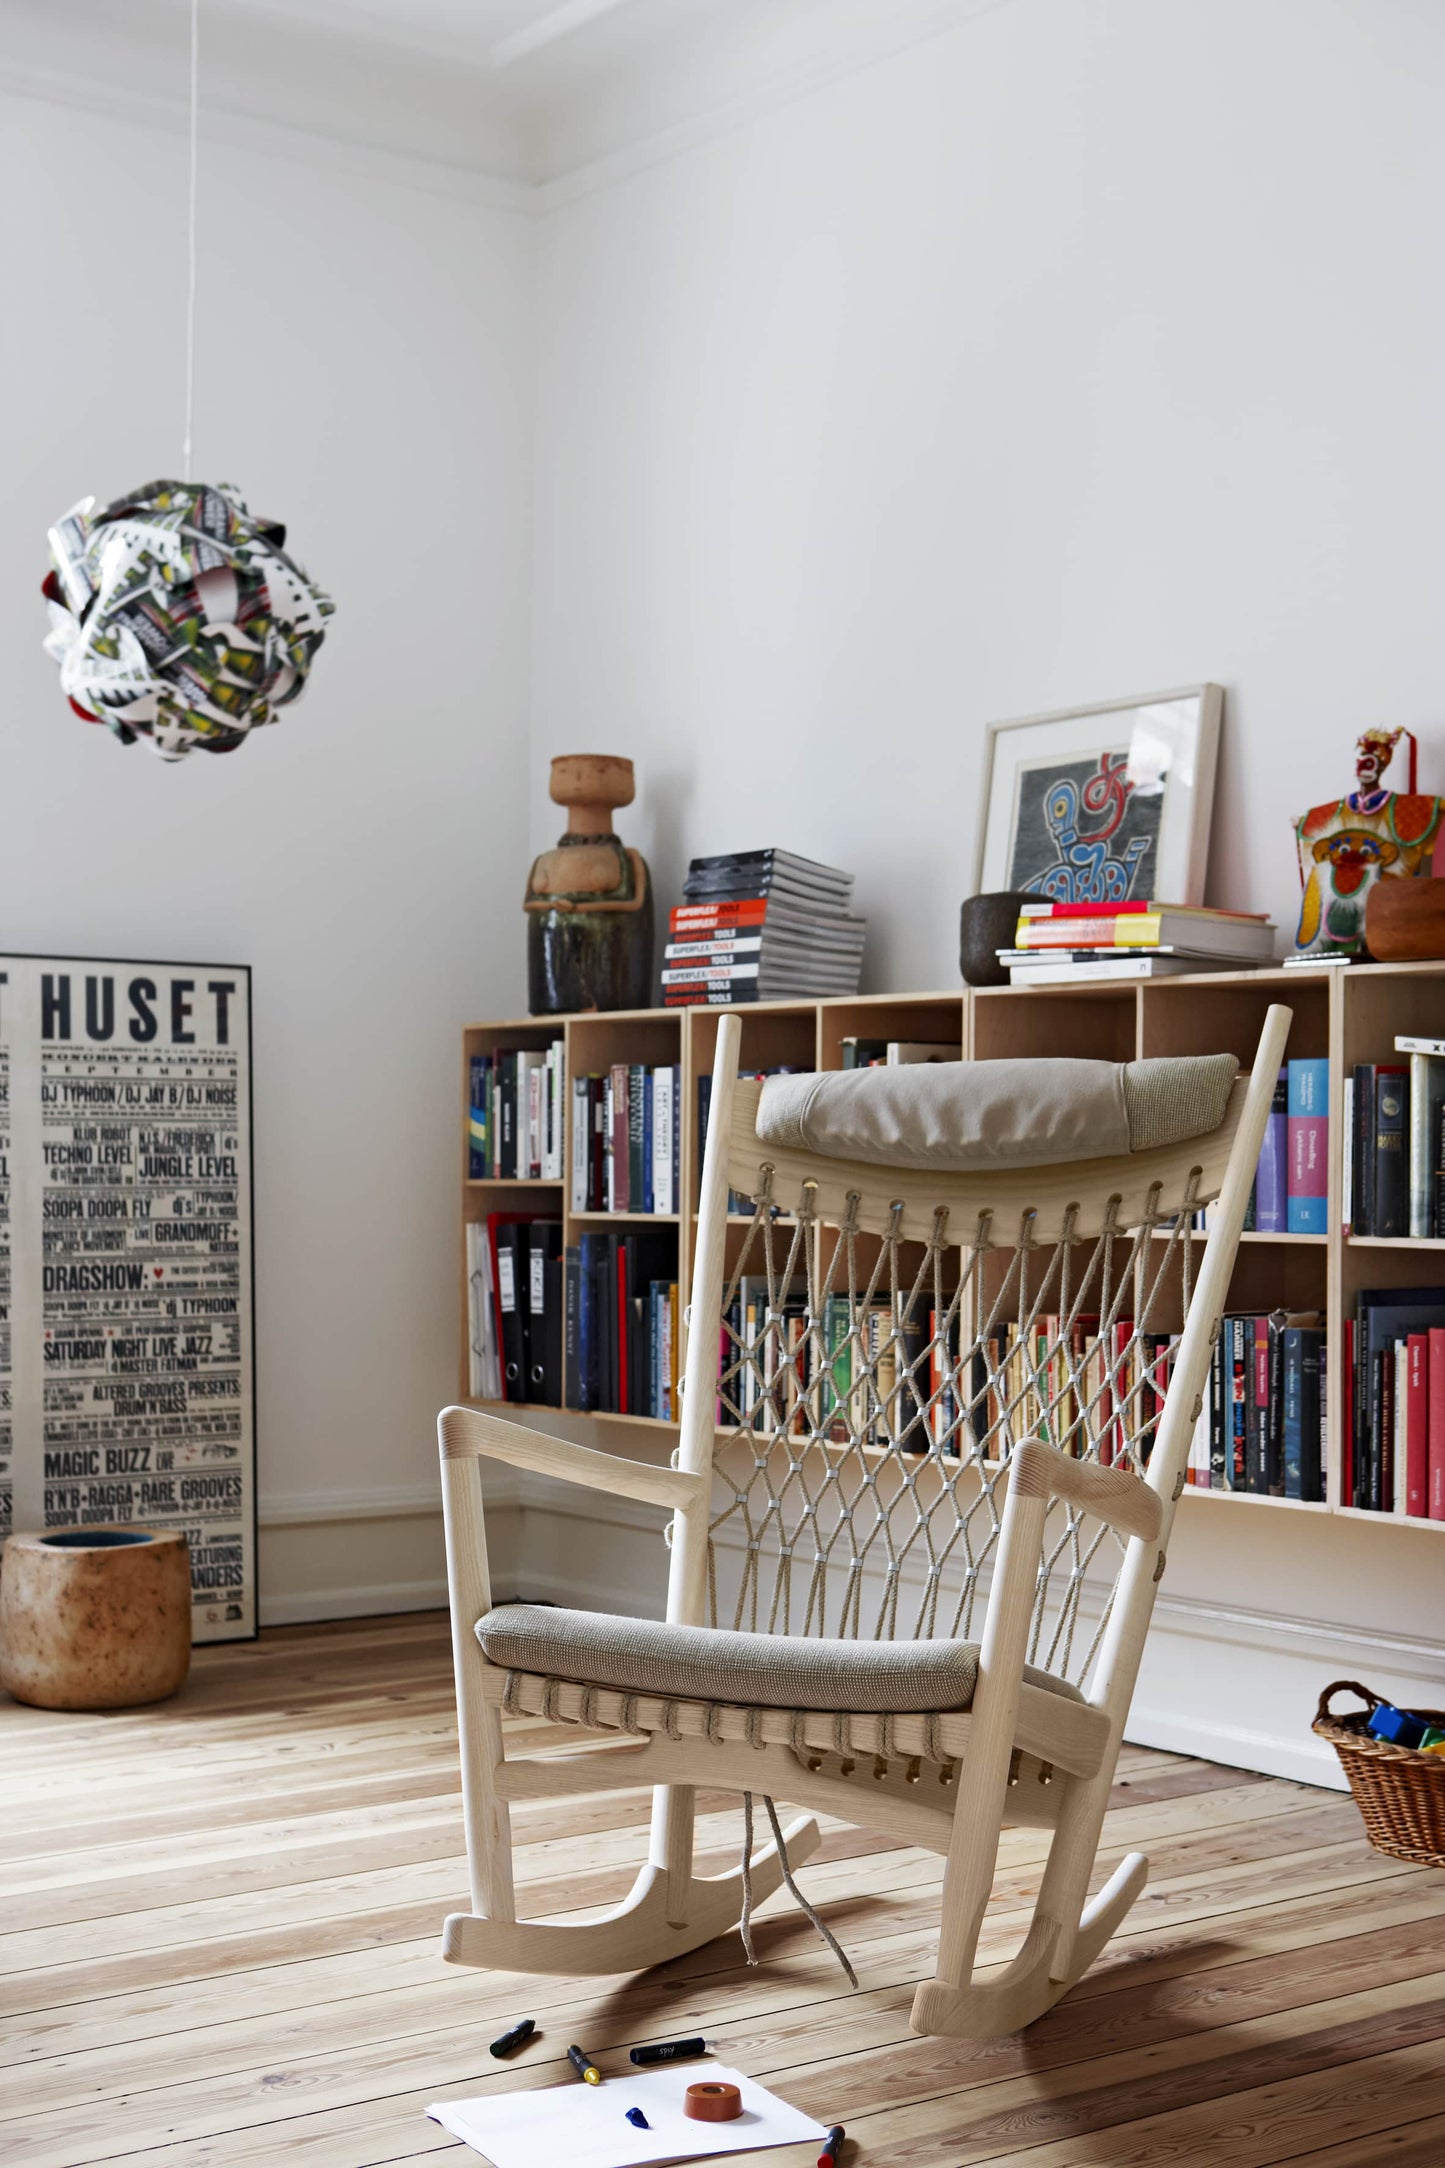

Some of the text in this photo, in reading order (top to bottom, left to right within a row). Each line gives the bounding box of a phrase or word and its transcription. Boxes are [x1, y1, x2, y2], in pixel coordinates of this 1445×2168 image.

[41, 974, 235, 1044] HUSET
[42, 1065, 237, 1077] SEPTEMBER
[146, 1089, 164, 1103] JAY
[206, 1089, 237, 1104] NOISE
[43, 1146, 133, 1164] TECHNO LEVEL
[139, 1156, 192, 1177] JUNGLE
[198, 1156, 238, 1177] LEVEL
[43, 1200, 82, 1218] SOOPA
[88, 1200, 128, 1217] DOOPA
[133, 1200, 152, 1217] FLY
[43, 1341, 106, 1361] SATURDAY
[112, 1338, 148, 1359] NIGHT
[152, 1337, 177, 1357] LIVE
[182, 1336, 212, 1355] JAZZ
[120, 1359, 158, 1373] MASTER
[161, 1358, 197, 1371] FATMAN
[93, 1384, 135, 1401] ALTERED
[138, 1382, 185, 1399] GROOVES
[1234, 1364, 1244, 1400] BYEN
[44, 1448, 174, 1477] MAGIC BUZZ LIVE
[1234, 1436, 1244, 1473] BYEN
[181, 1478, 241, 1500] GROOVES
[118, 1507, 133, 1521] FLY
[190, 1548, 242, 1566] EATURING
